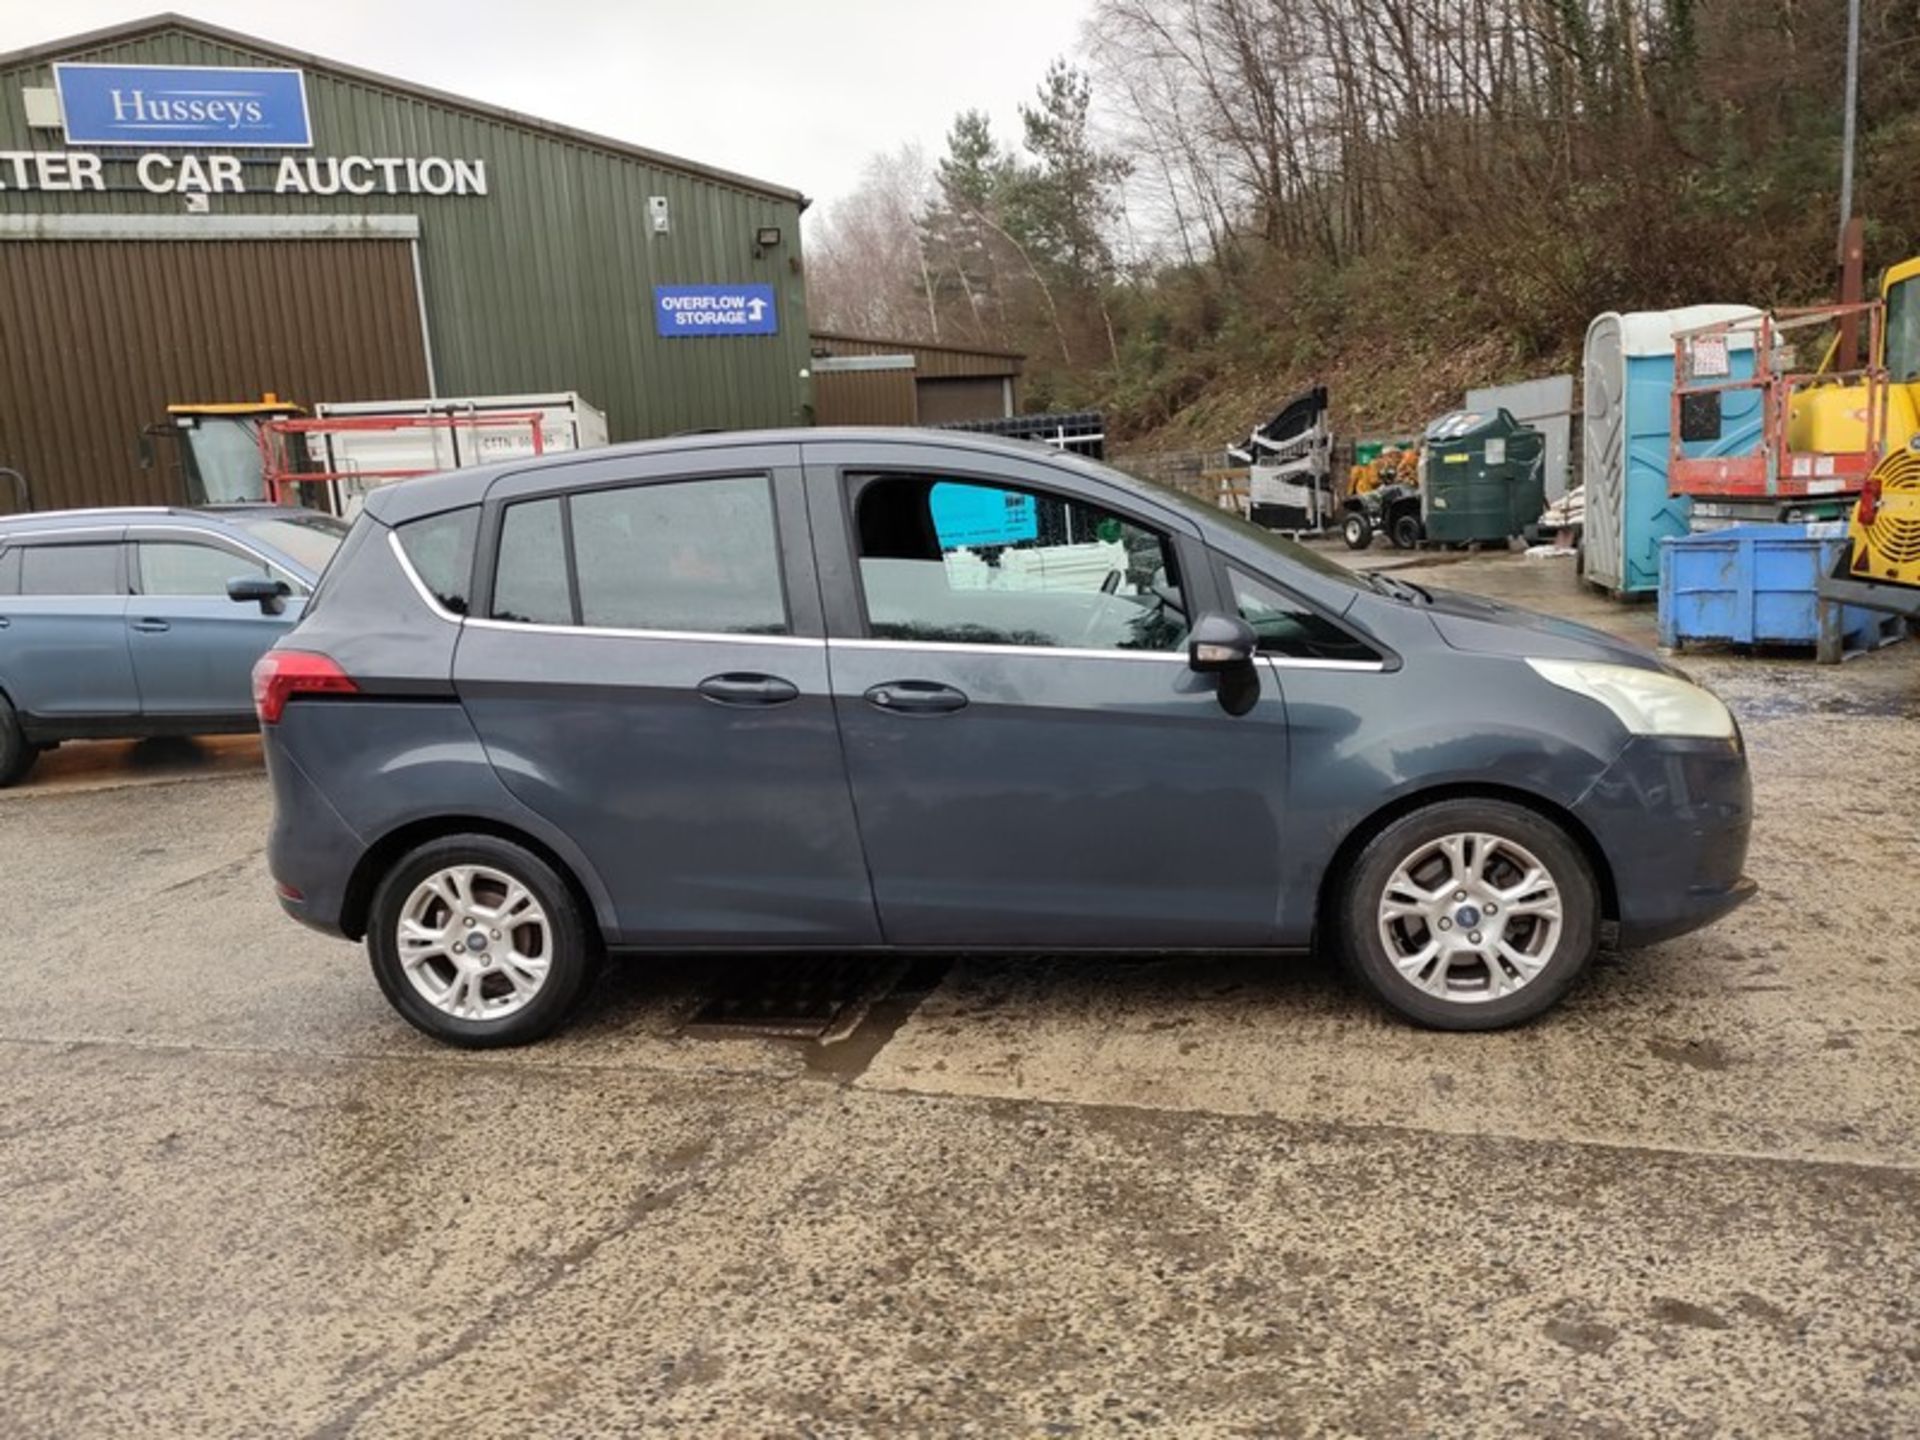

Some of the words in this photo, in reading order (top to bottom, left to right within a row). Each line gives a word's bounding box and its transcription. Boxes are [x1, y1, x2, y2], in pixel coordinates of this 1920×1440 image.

[110, 88, 263, 130] Husseys
[0, 150, 106, 190] TER
[136, 152, 246, 194] CAR
[274, 155, 488, 196] AUCTION
[661, 296, 746, 311] OVERFLOW
[675, 311, 747, 325] STORAGE
